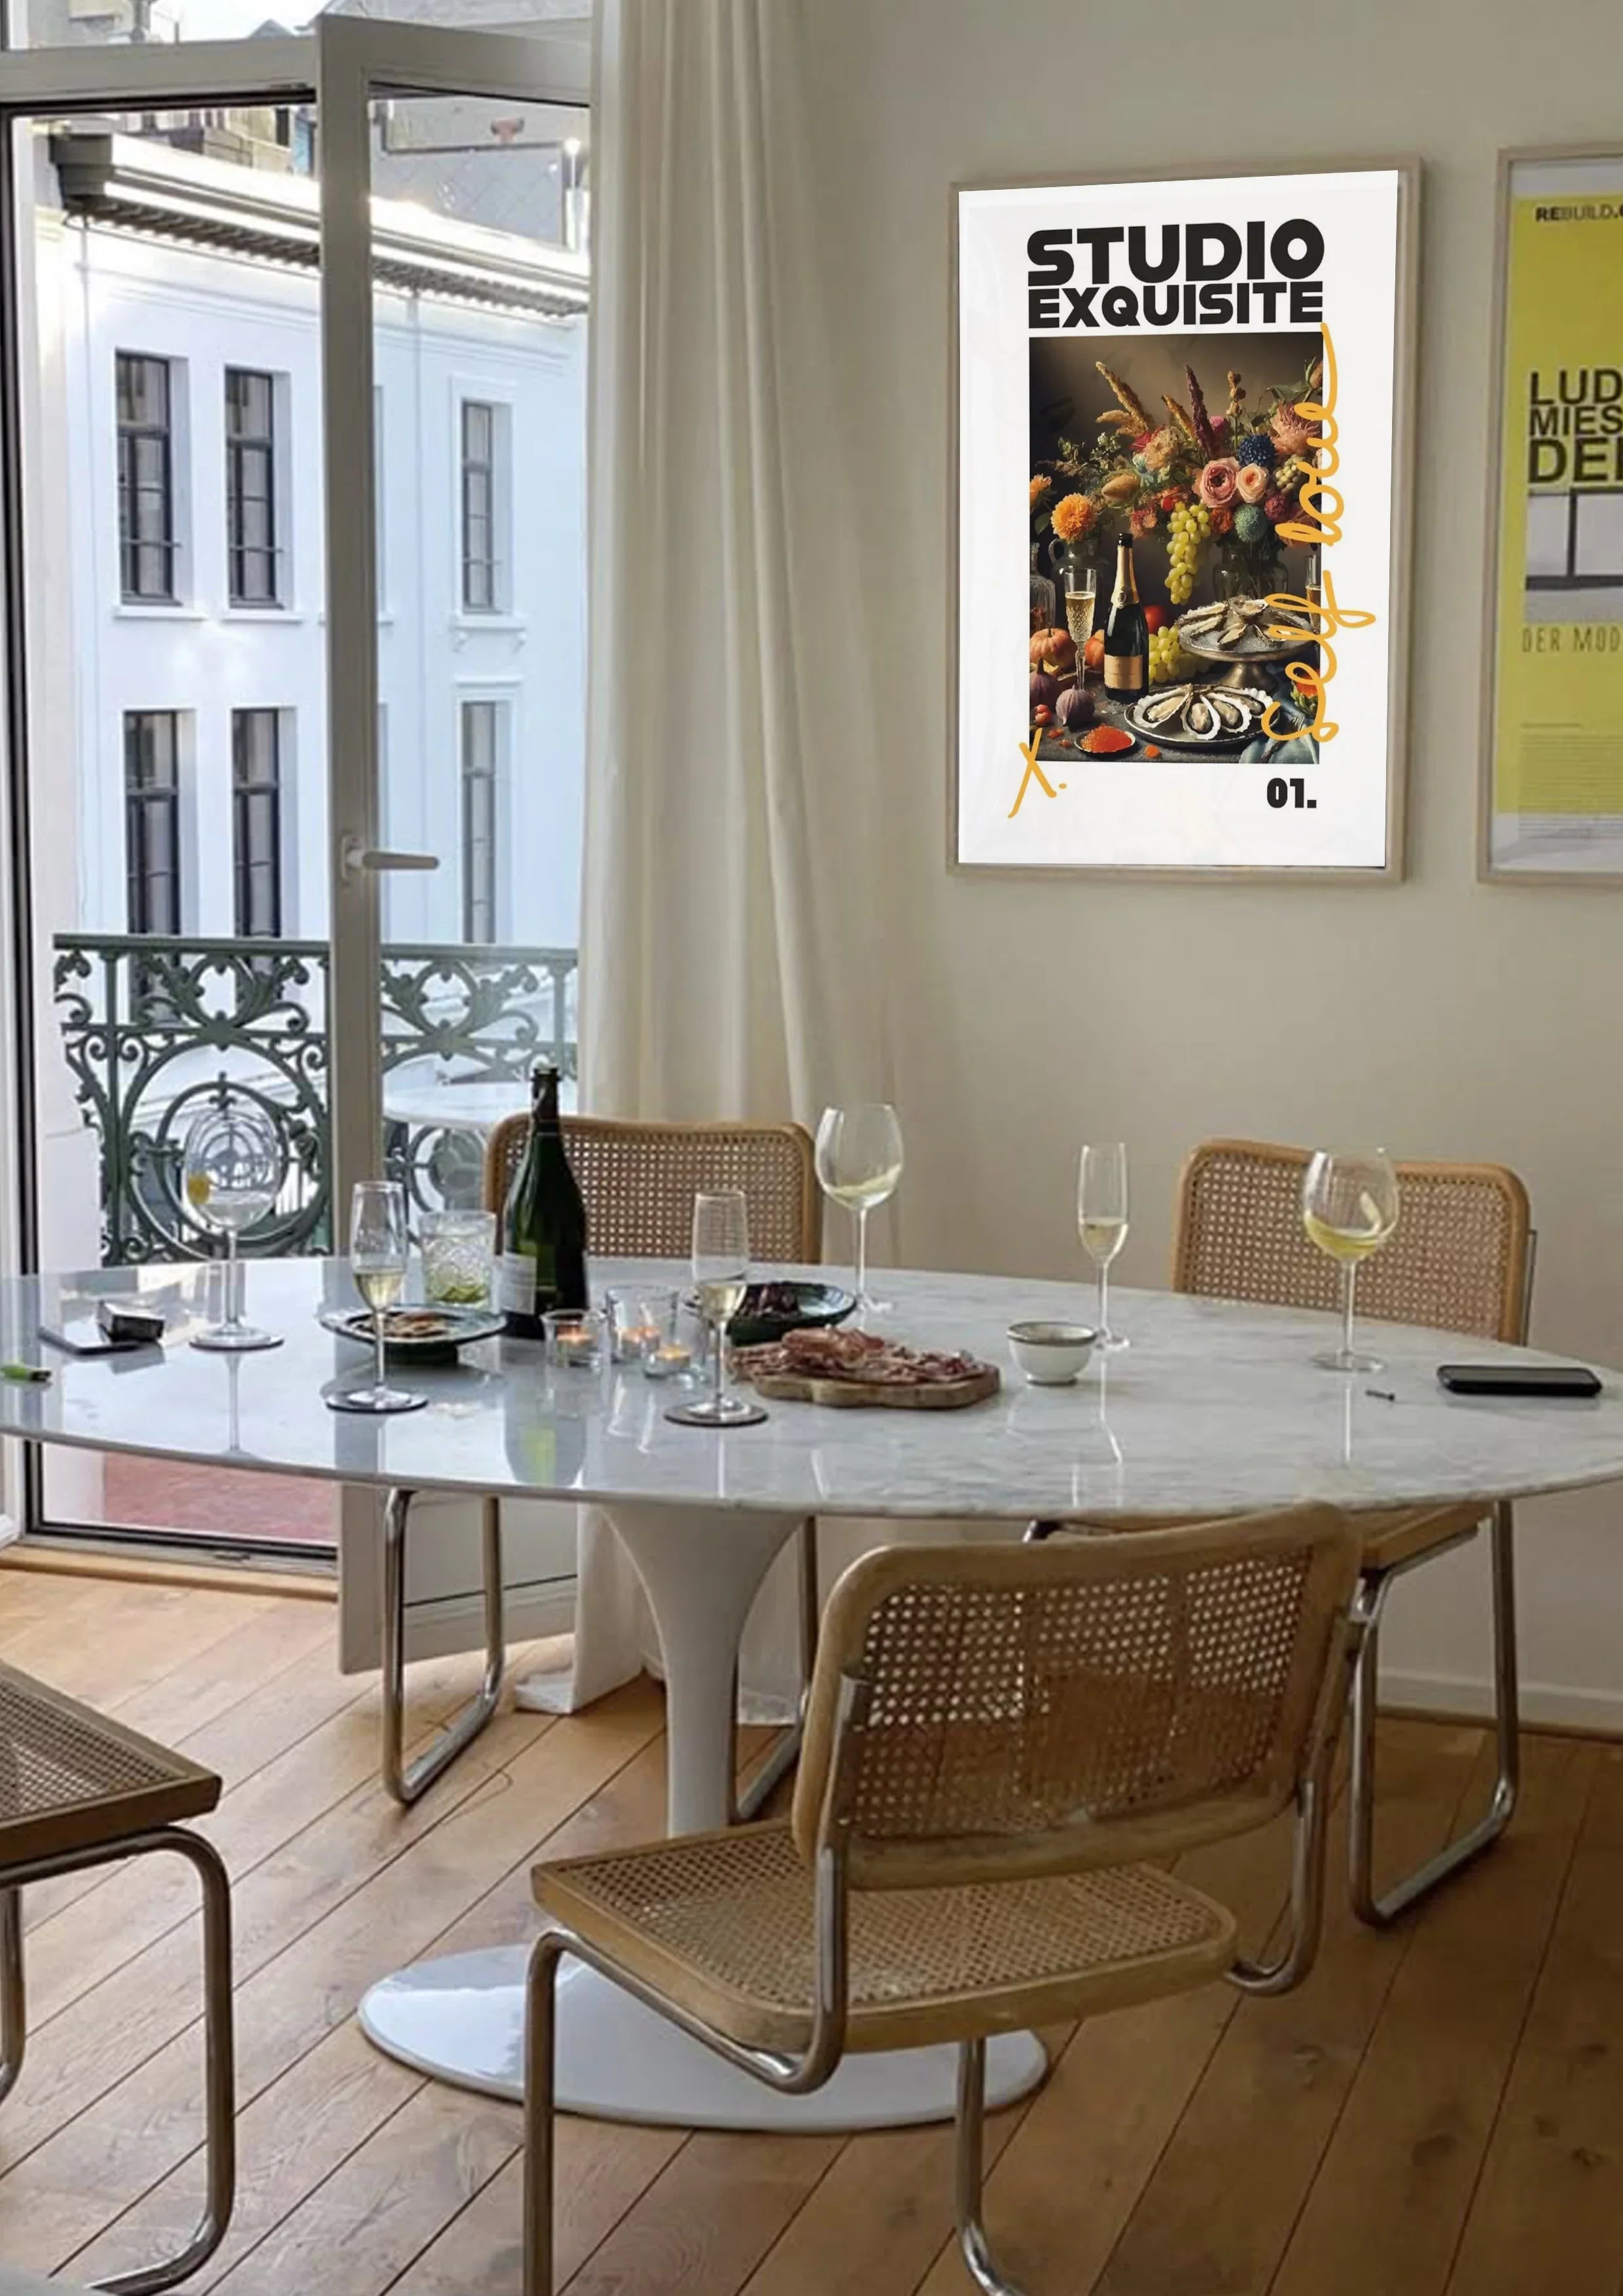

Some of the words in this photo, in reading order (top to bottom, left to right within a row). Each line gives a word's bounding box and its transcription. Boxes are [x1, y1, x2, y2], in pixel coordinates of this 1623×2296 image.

[1027, 219, 1325, 287] STUDIO
[1028, 281, 1323, 329] EXQUISITE
[1529, 405, 1623, 437] MIES
[1527, 437, 1623, 484] DE
[1522, 627, 1561, 653] DER
[1266, 778, 1317, 809] 01.
